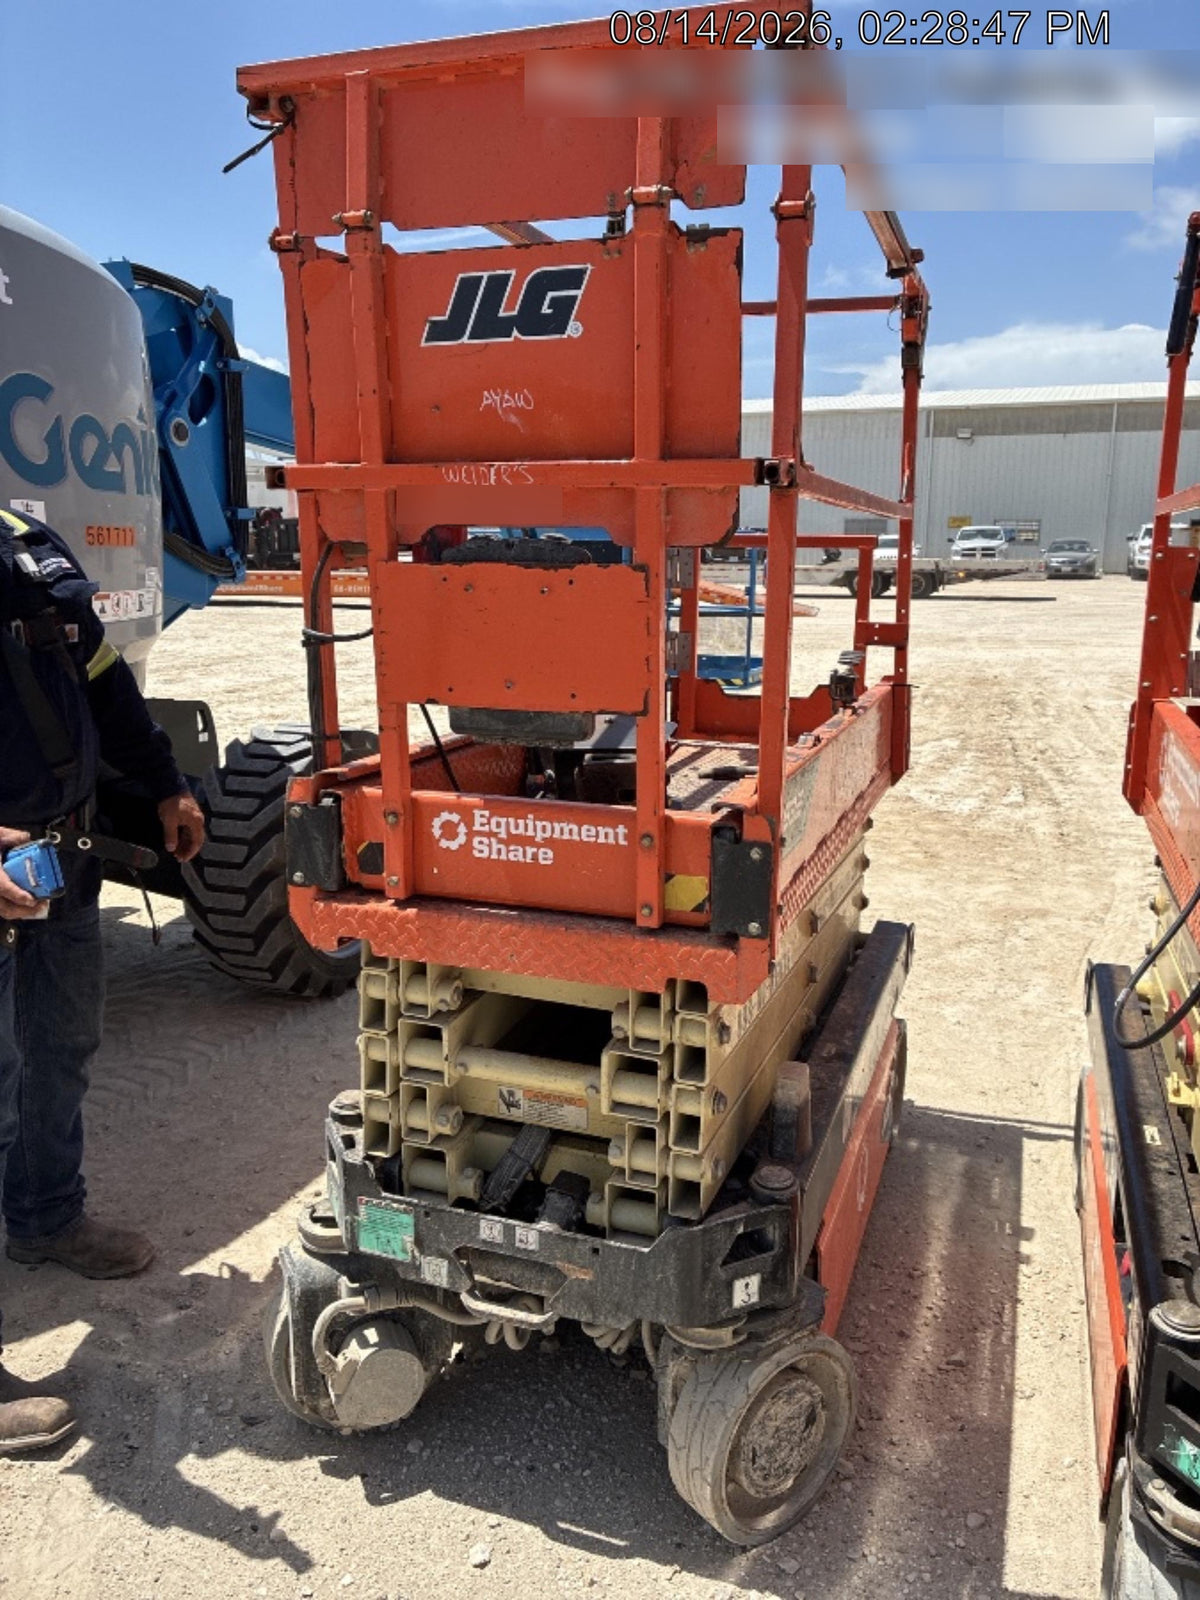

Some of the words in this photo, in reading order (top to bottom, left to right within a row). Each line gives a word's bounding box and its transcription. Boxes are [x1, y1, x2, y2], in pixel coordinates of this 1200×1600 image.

[421, 264, 592, 347] JLG
[472, 809, 628, 846] Equipment
[472, 836, 554, 865] Share
